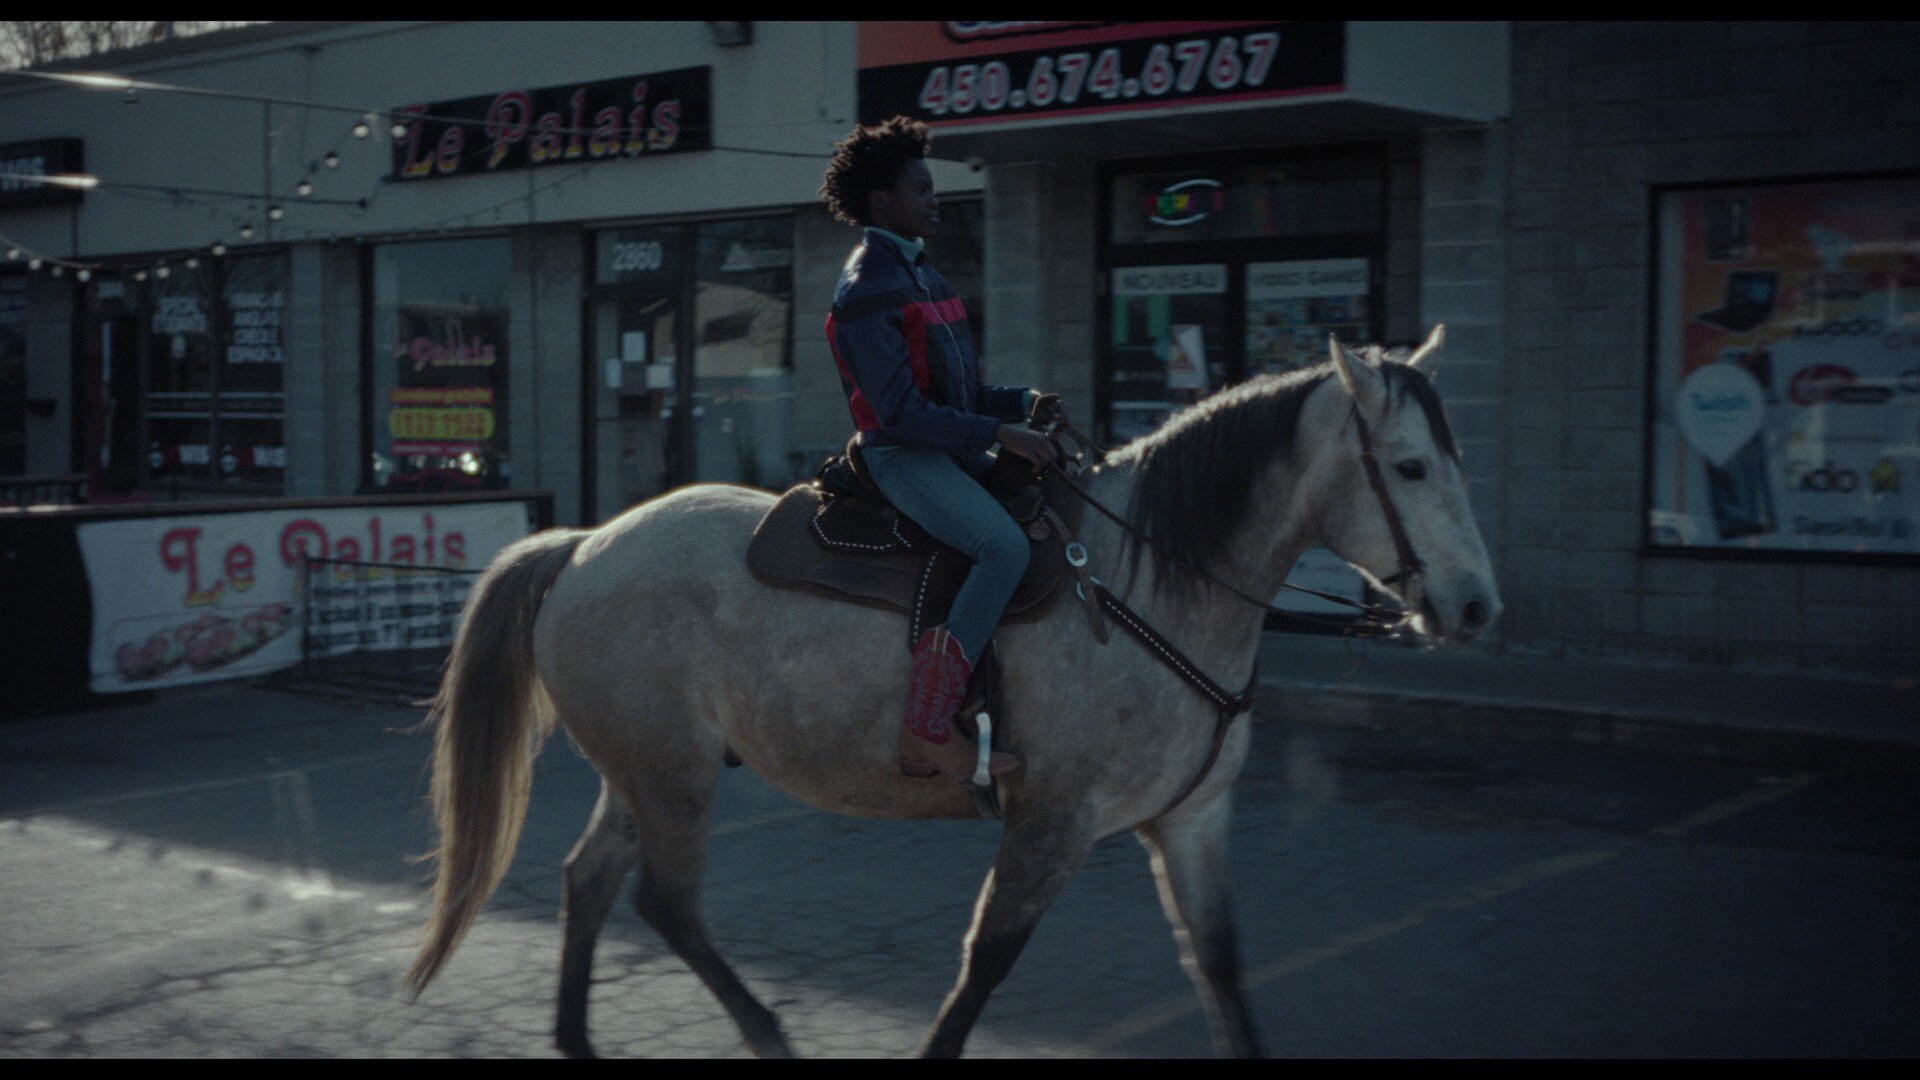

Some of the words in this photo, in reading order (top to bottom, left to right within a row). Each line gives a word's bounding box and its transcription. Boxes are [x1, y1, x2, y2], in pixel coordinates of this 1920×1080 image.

[919, 31, 1280, 115] 450.674.6767
[394, 102, 464, 176] Le
[486, 81, 682, 168] Palais
[1121, 271, 1219, 290] NOUVEAU
[160, 527, 255, 604] Le
[279, 512, 466, 602] Palais
